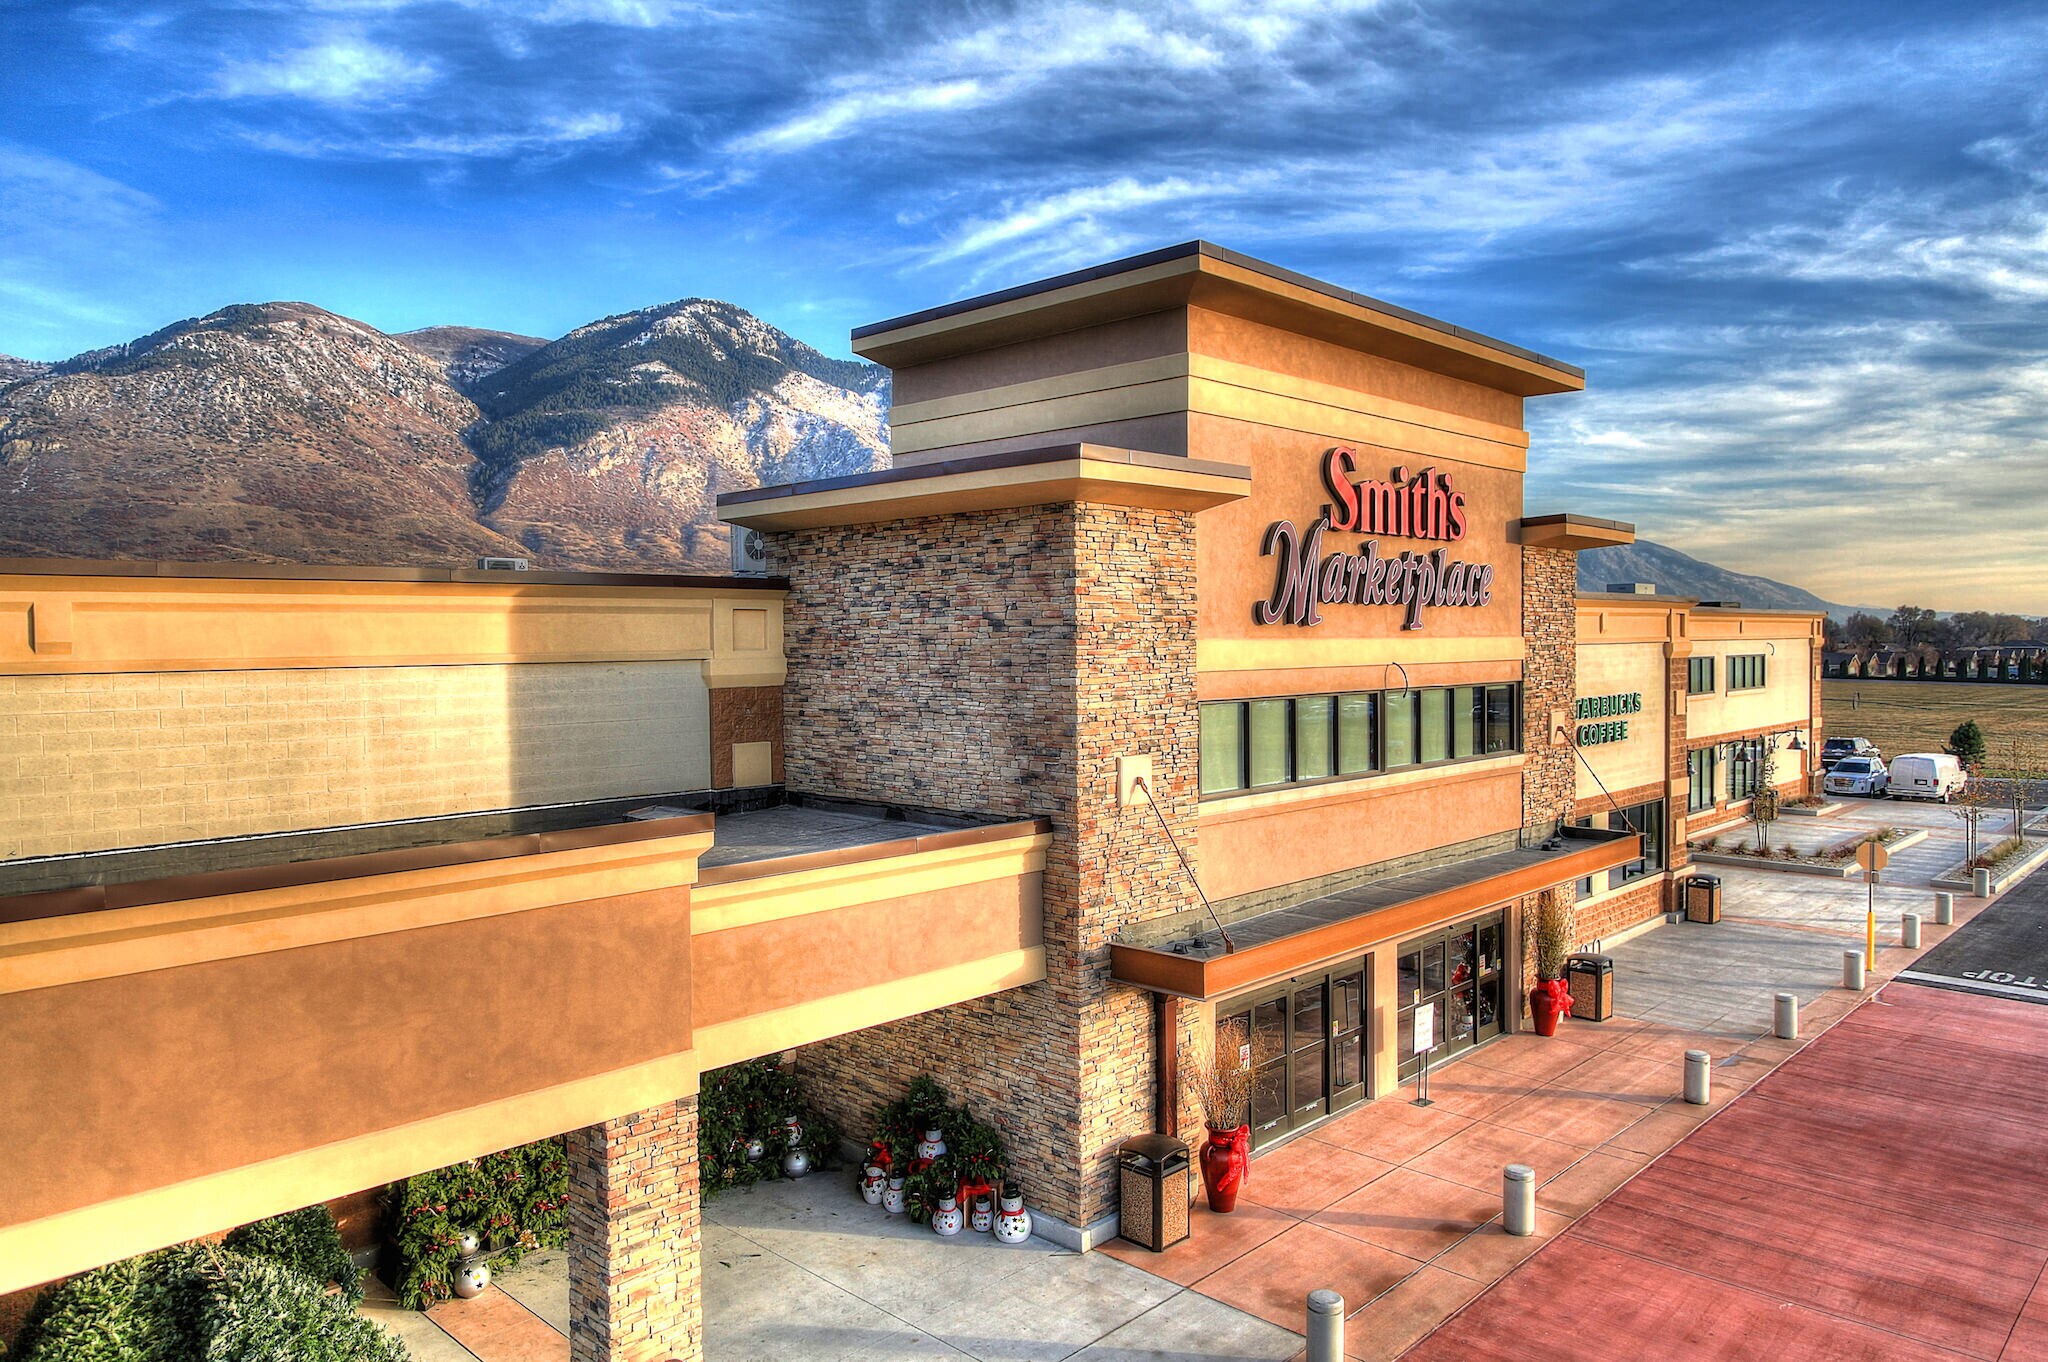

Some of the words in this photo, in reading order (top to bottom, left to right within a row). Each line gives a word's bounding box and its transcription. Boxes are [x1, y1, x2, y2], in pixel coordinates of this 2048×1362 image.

[1322, 446, 1467, 541] Smith's
[1255, 518, 1494, 630] Marketplace
[1575, 692, 1642, 720] TARBUCKS
[1577, 720, 1629, 747] COFFEE
